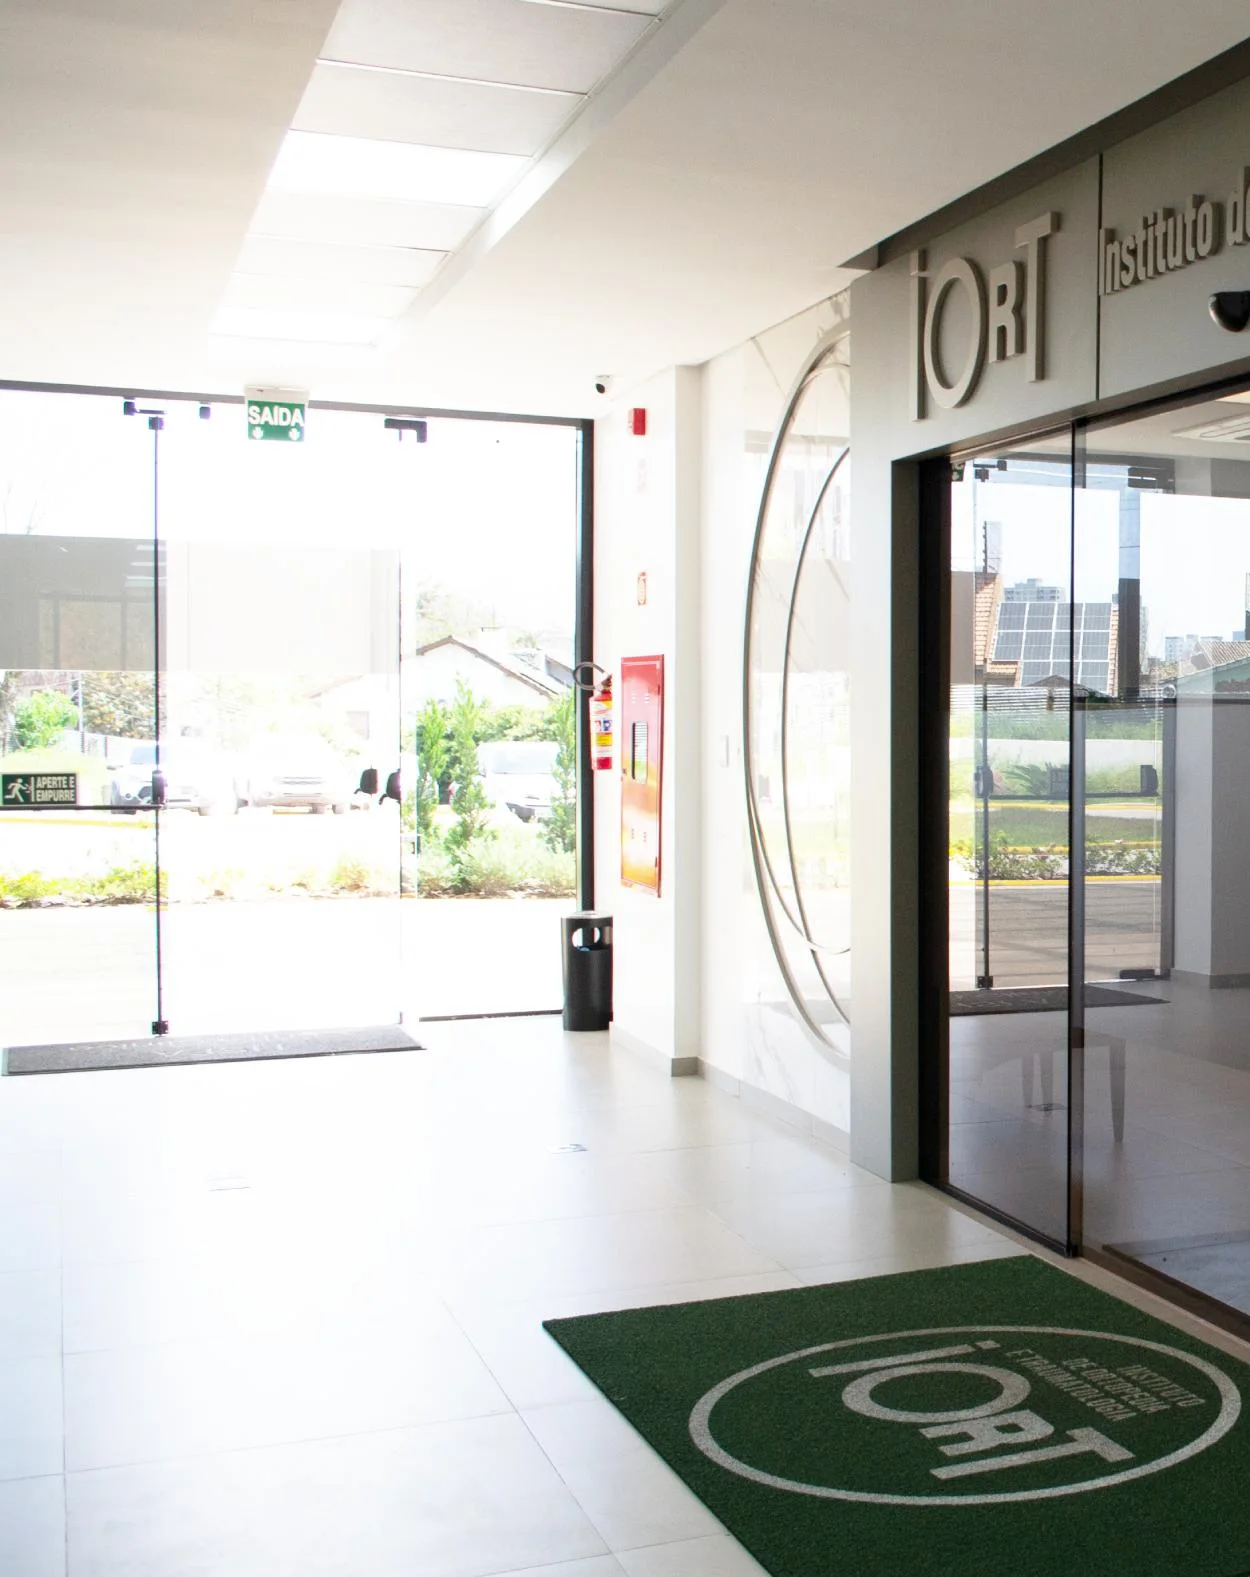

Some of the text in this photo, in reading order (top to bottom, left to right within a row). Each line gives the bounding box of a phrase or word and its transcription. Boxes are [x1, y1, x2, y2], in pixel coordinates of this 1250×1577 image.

[1098, 195, 1217, 296] Instituto
[36, 776, 75, 788] APERTE E
[36, 789, 75, 801] EMPURRE
[1016, 1354, 1138, 1422] TRAUMATOLOGIA
[1062, 1358, 1172, 1414] DE ORTOPEDIA
[1116, 1364, 1206, 1407] INSTITUTO
